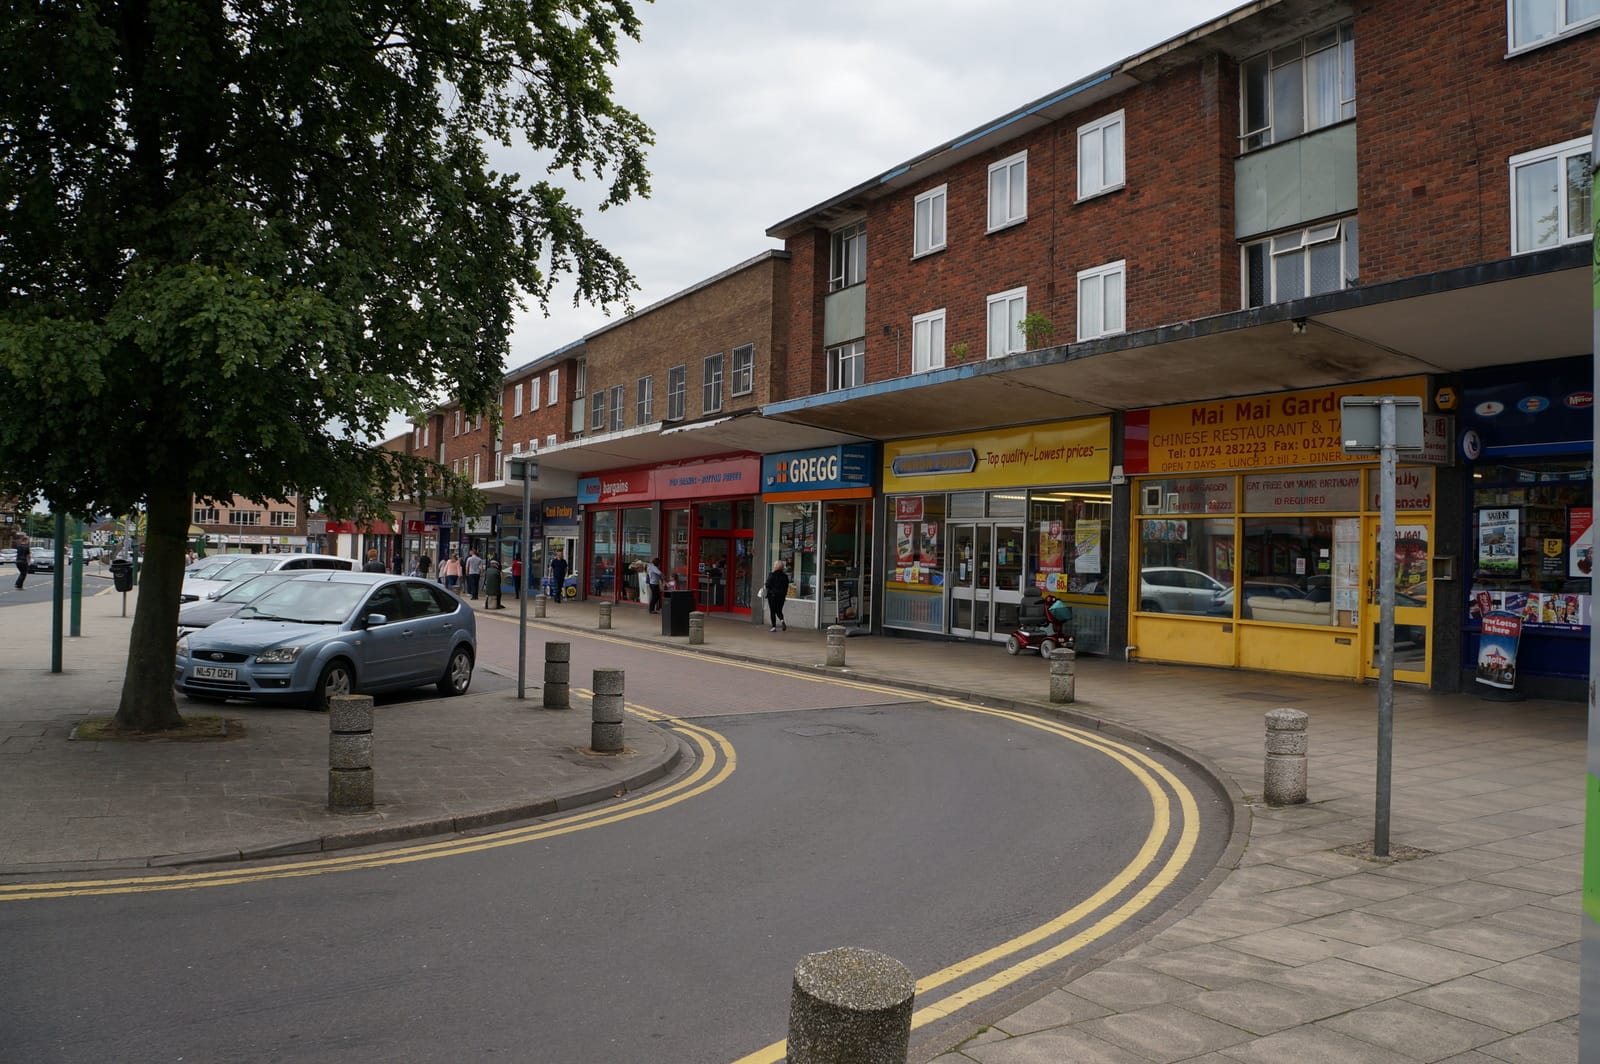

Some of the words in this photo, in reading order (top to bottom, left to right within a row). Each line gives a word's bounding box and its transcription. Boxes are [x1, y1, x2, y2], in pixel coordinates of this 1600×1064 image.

[1191, 405, 1224, 426] Mai
[1235, 400, 1271, 421] Mai
[1152, 430, 1208, 447] CHINESE
[1213, 421, 1309, 442] RESTAURANT
[1311, 420, 1322, 434] &
[986, 451, 999, 468] Top
[1066, 443, 1095, 463] prices
[1168, 448, 1186, 459] Tel:
[1189, 446, 1222, 458] 01724
[1225, 442, 1266, 455] 282223
[1274, 440, 1298, 451] Fax:
[1162, 463, 1184, 472] OPEN
[1186, 461, 1192, 470] 7
[1194, 460, 1216, 470] DAYS
[1229, 456, 1259, 468] LUNCH
[1264, 456, 1274, 465] 12
[1292, 454, 1298, 463] 2
[1309, 452, 1342, 462] DINER
[603, 479, 629, 497] bargains
[1246, 481, 1260, 491] EAT
[1262, 480, 1282, 490] FREE
[1284, 480, 1295, 489] ON
[1320, 477, 1359, 488] BIRTHDAY
[1274, 497, 1282, 506] ID
[1283, 496, 1325, 505] REQUIRED
[1487, 511, 1509, 520] WIN
[1492, 625, 1511, 635] here
[1496, 619, 1518, 629] Lotto
[196, 667, 216, 677] NL57
